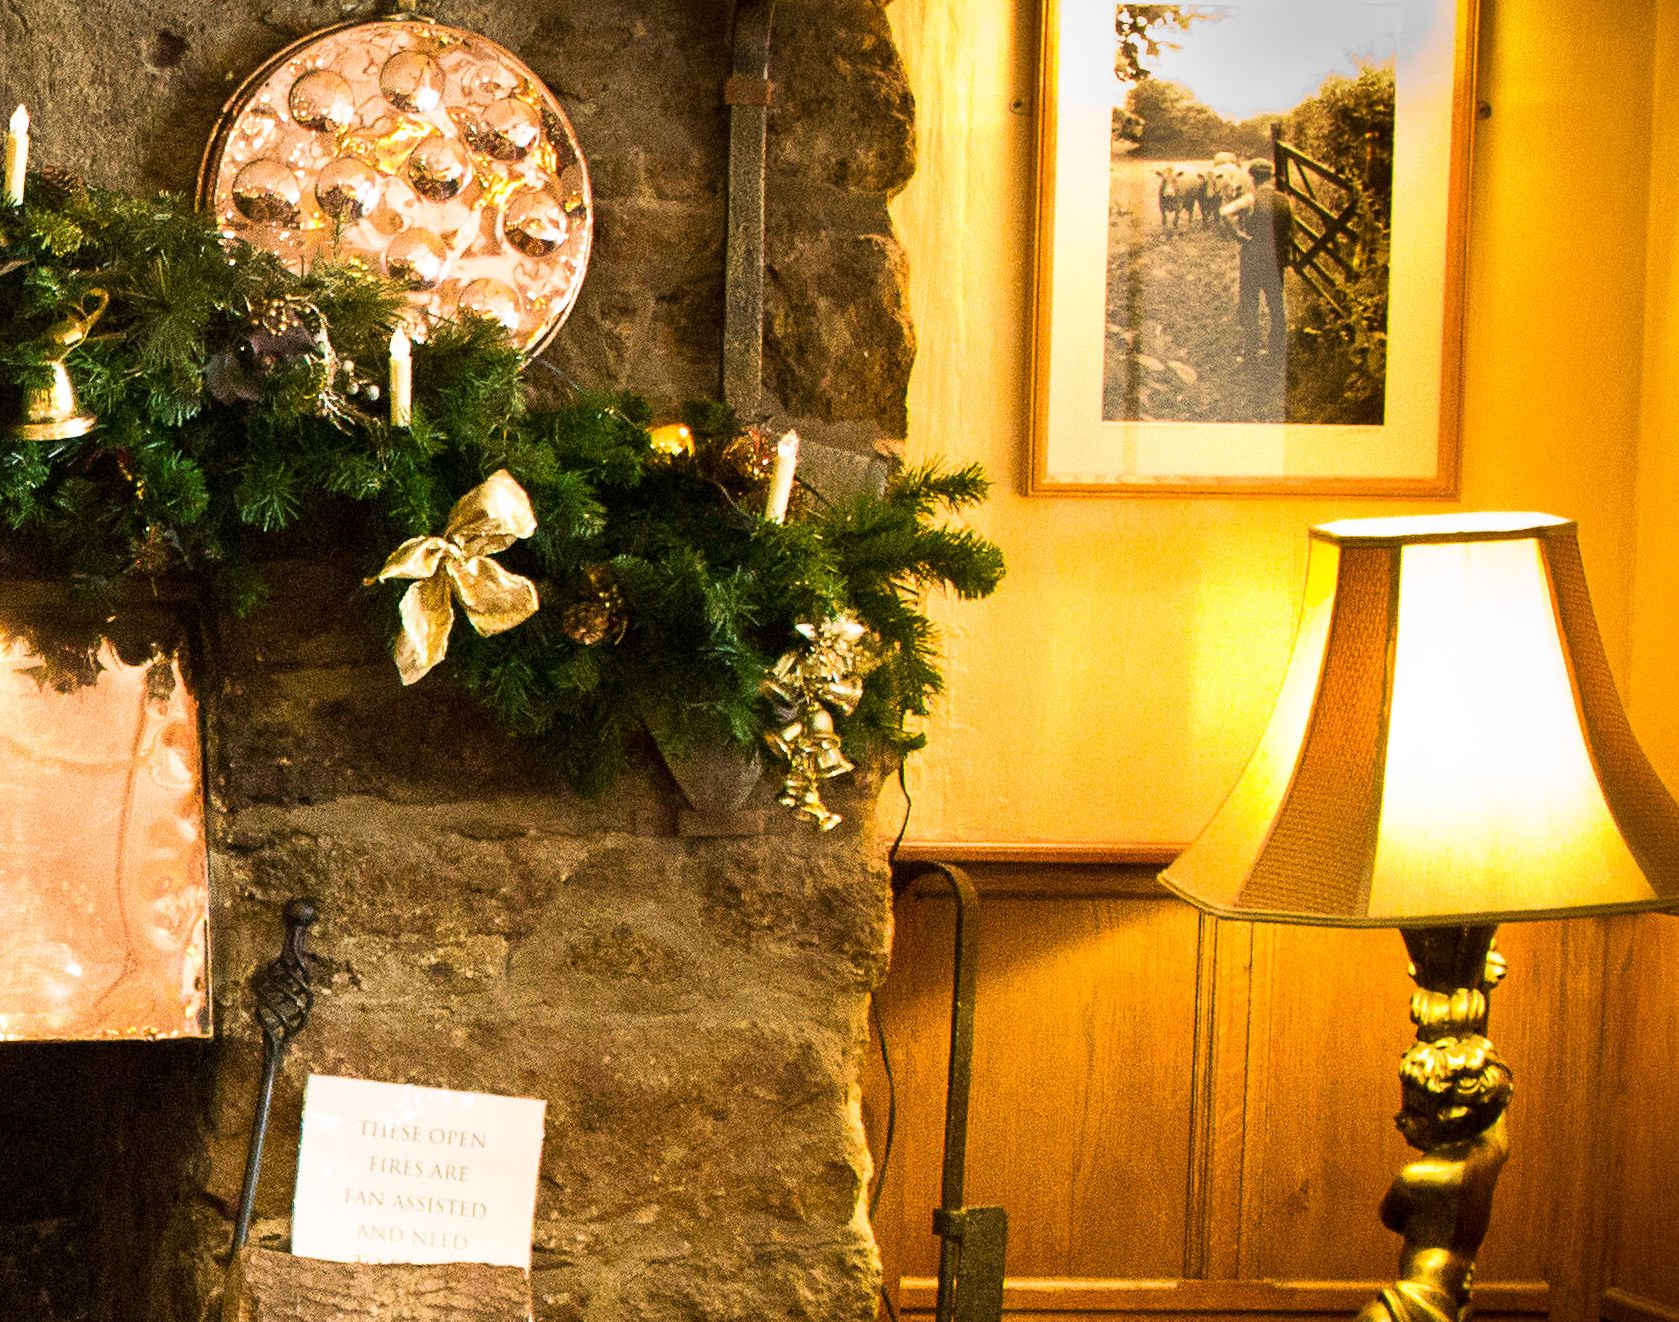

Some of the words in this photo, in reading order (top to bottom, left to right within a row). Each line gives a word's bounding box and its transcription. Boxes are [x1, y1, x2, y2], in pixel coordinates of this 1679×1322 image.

[358, 1119, 422, 1143] THESE
[428, 1128, 487, 1149] OPEN
[369, 1155, 423, 1177] FIRES
[428, 1163, 470, 1183] ARE
[345, 1187, 385, 1206] FAN
[390, 1193, 487, 1219] ASSISTED
[356, 1224, 404, 1243] AND
[412, 1231, 469, 1250] NEED
